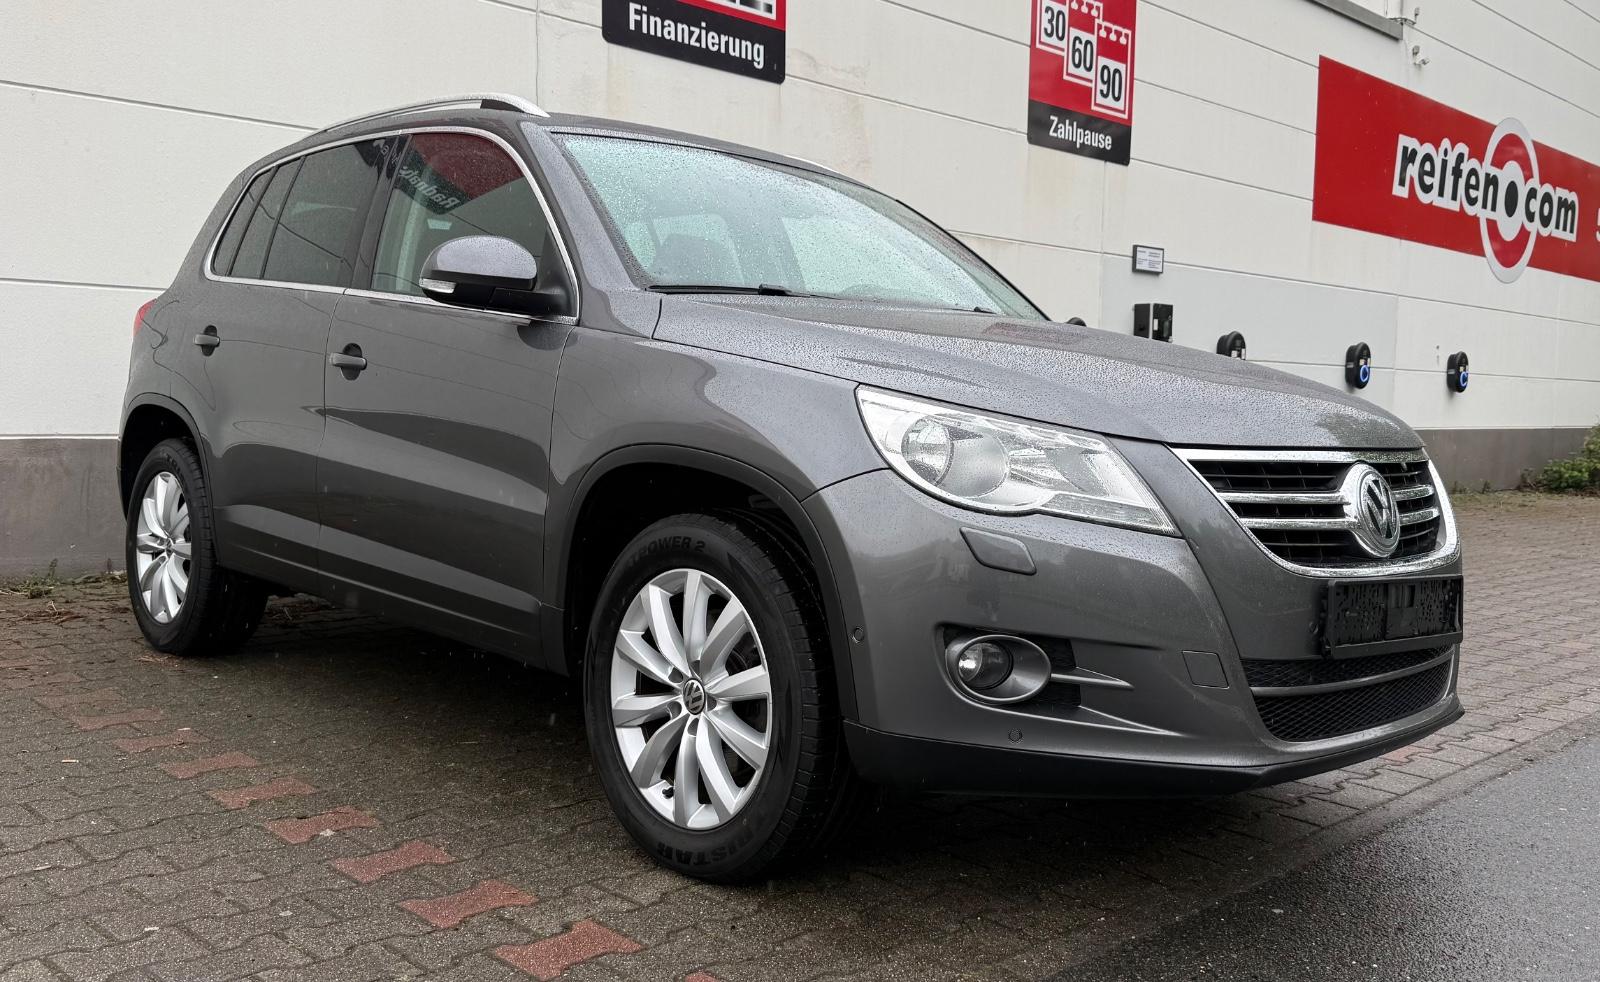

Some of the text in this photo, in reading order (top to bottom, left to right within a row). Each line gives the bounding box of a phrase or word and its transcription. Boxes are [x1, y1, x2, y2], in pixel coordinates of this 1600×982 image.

[628, 2, 765, 69] Finanzierung
[1043, 6, 1066, 42] 30
[1071, 35, 1094, 72] 60
[1099, 65, 1123, 102] 90
[1049, 115, 1112, 150] Zahlpause
